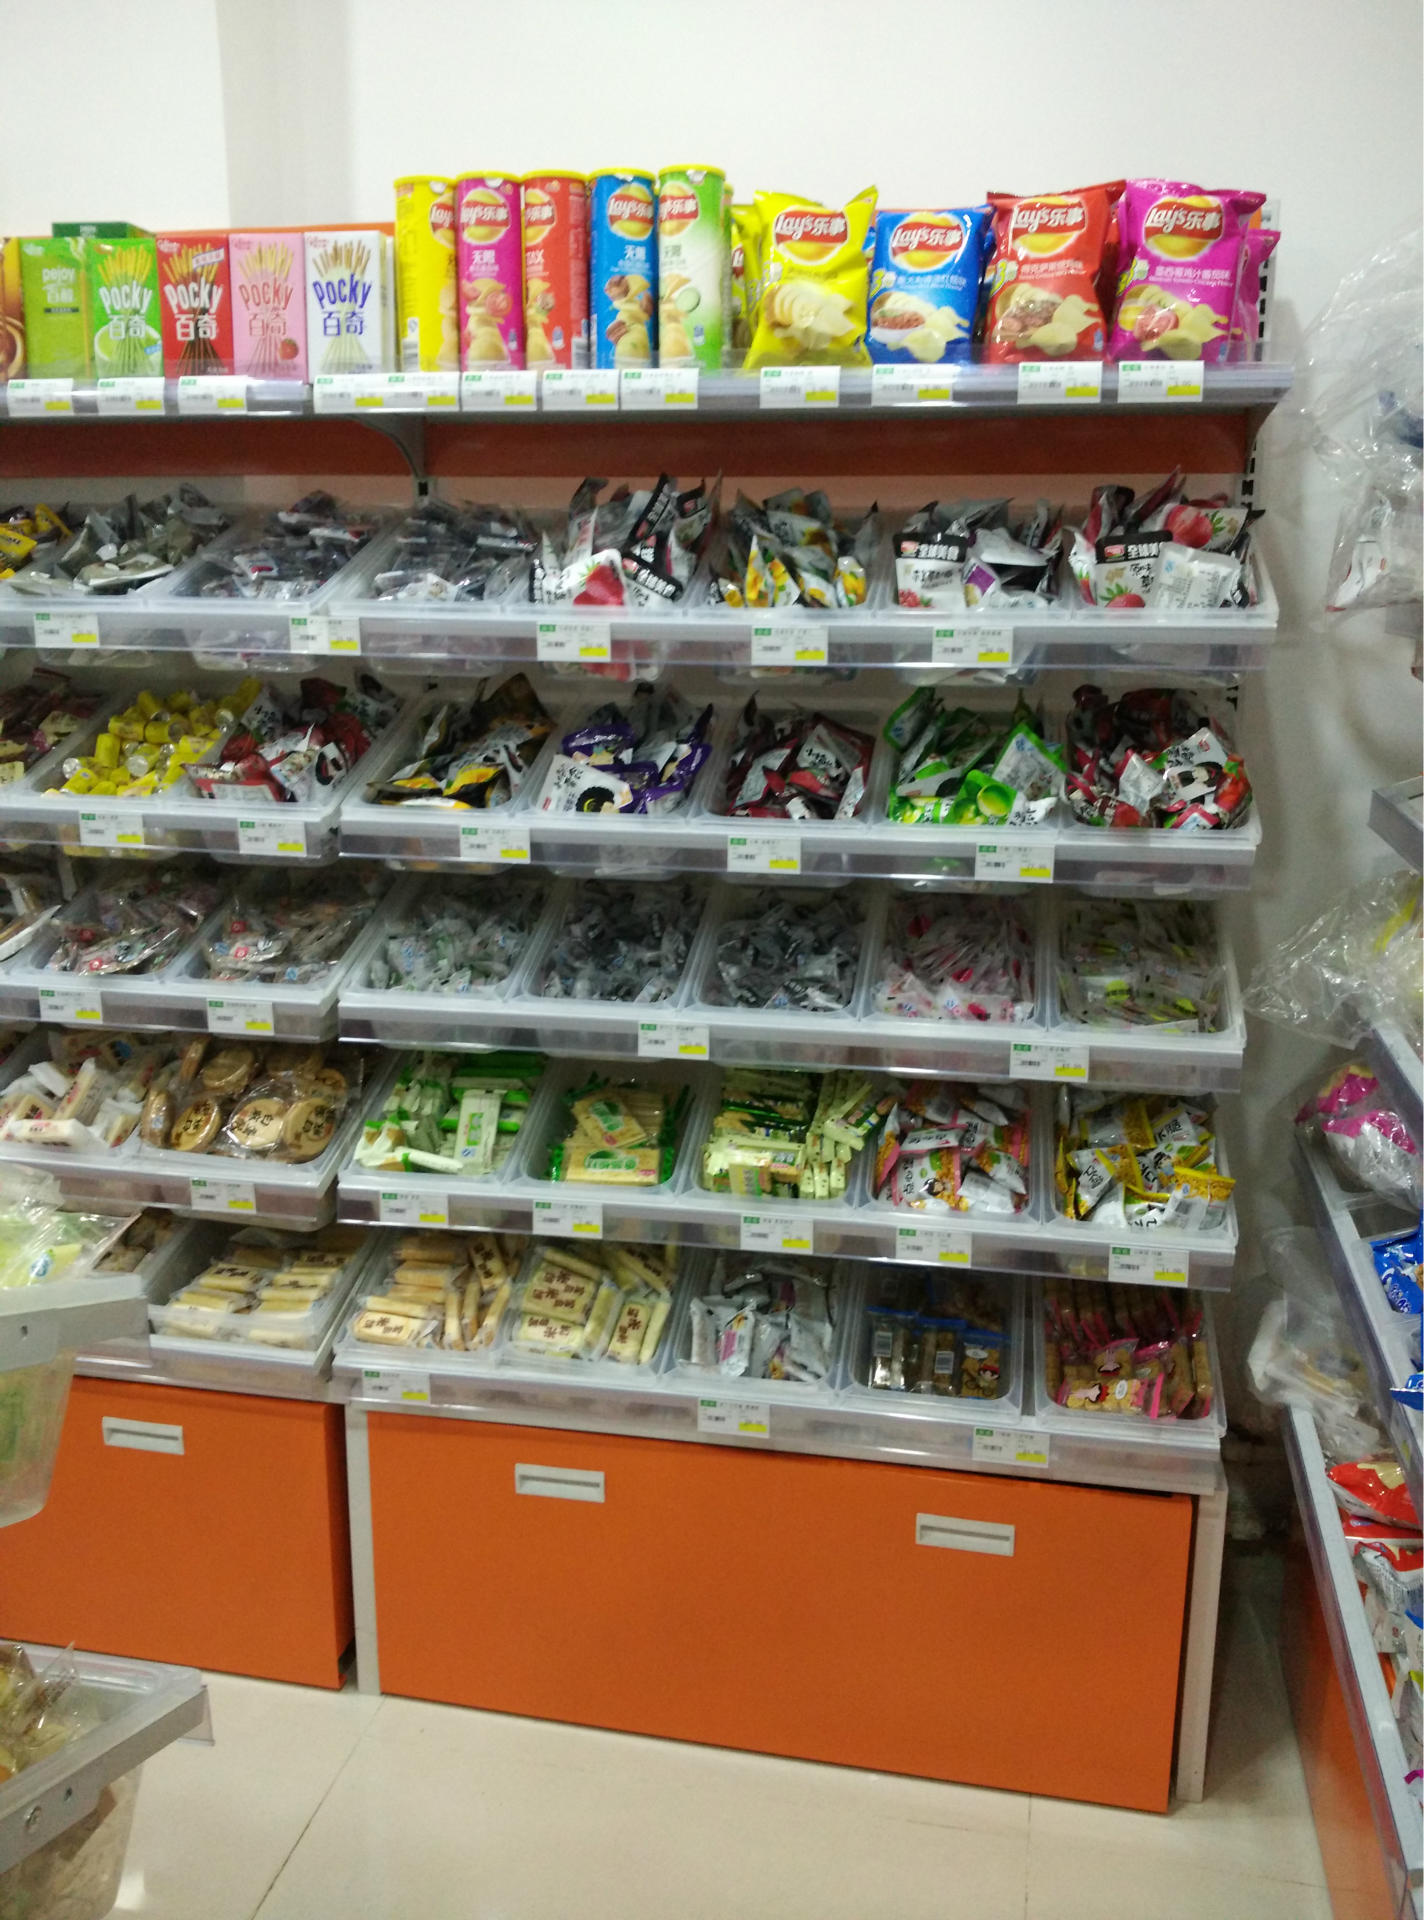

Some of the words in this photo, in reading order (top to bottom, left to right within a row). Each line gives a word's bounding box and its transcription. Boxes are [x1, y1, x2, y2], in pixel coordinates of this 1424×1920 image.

[108, 314, 146, 340] 百奇
[174, 314, 218, 341] 百奇
[249, 307, 287, 337] 百奇
[322, 311, 366, 336] 百奇
